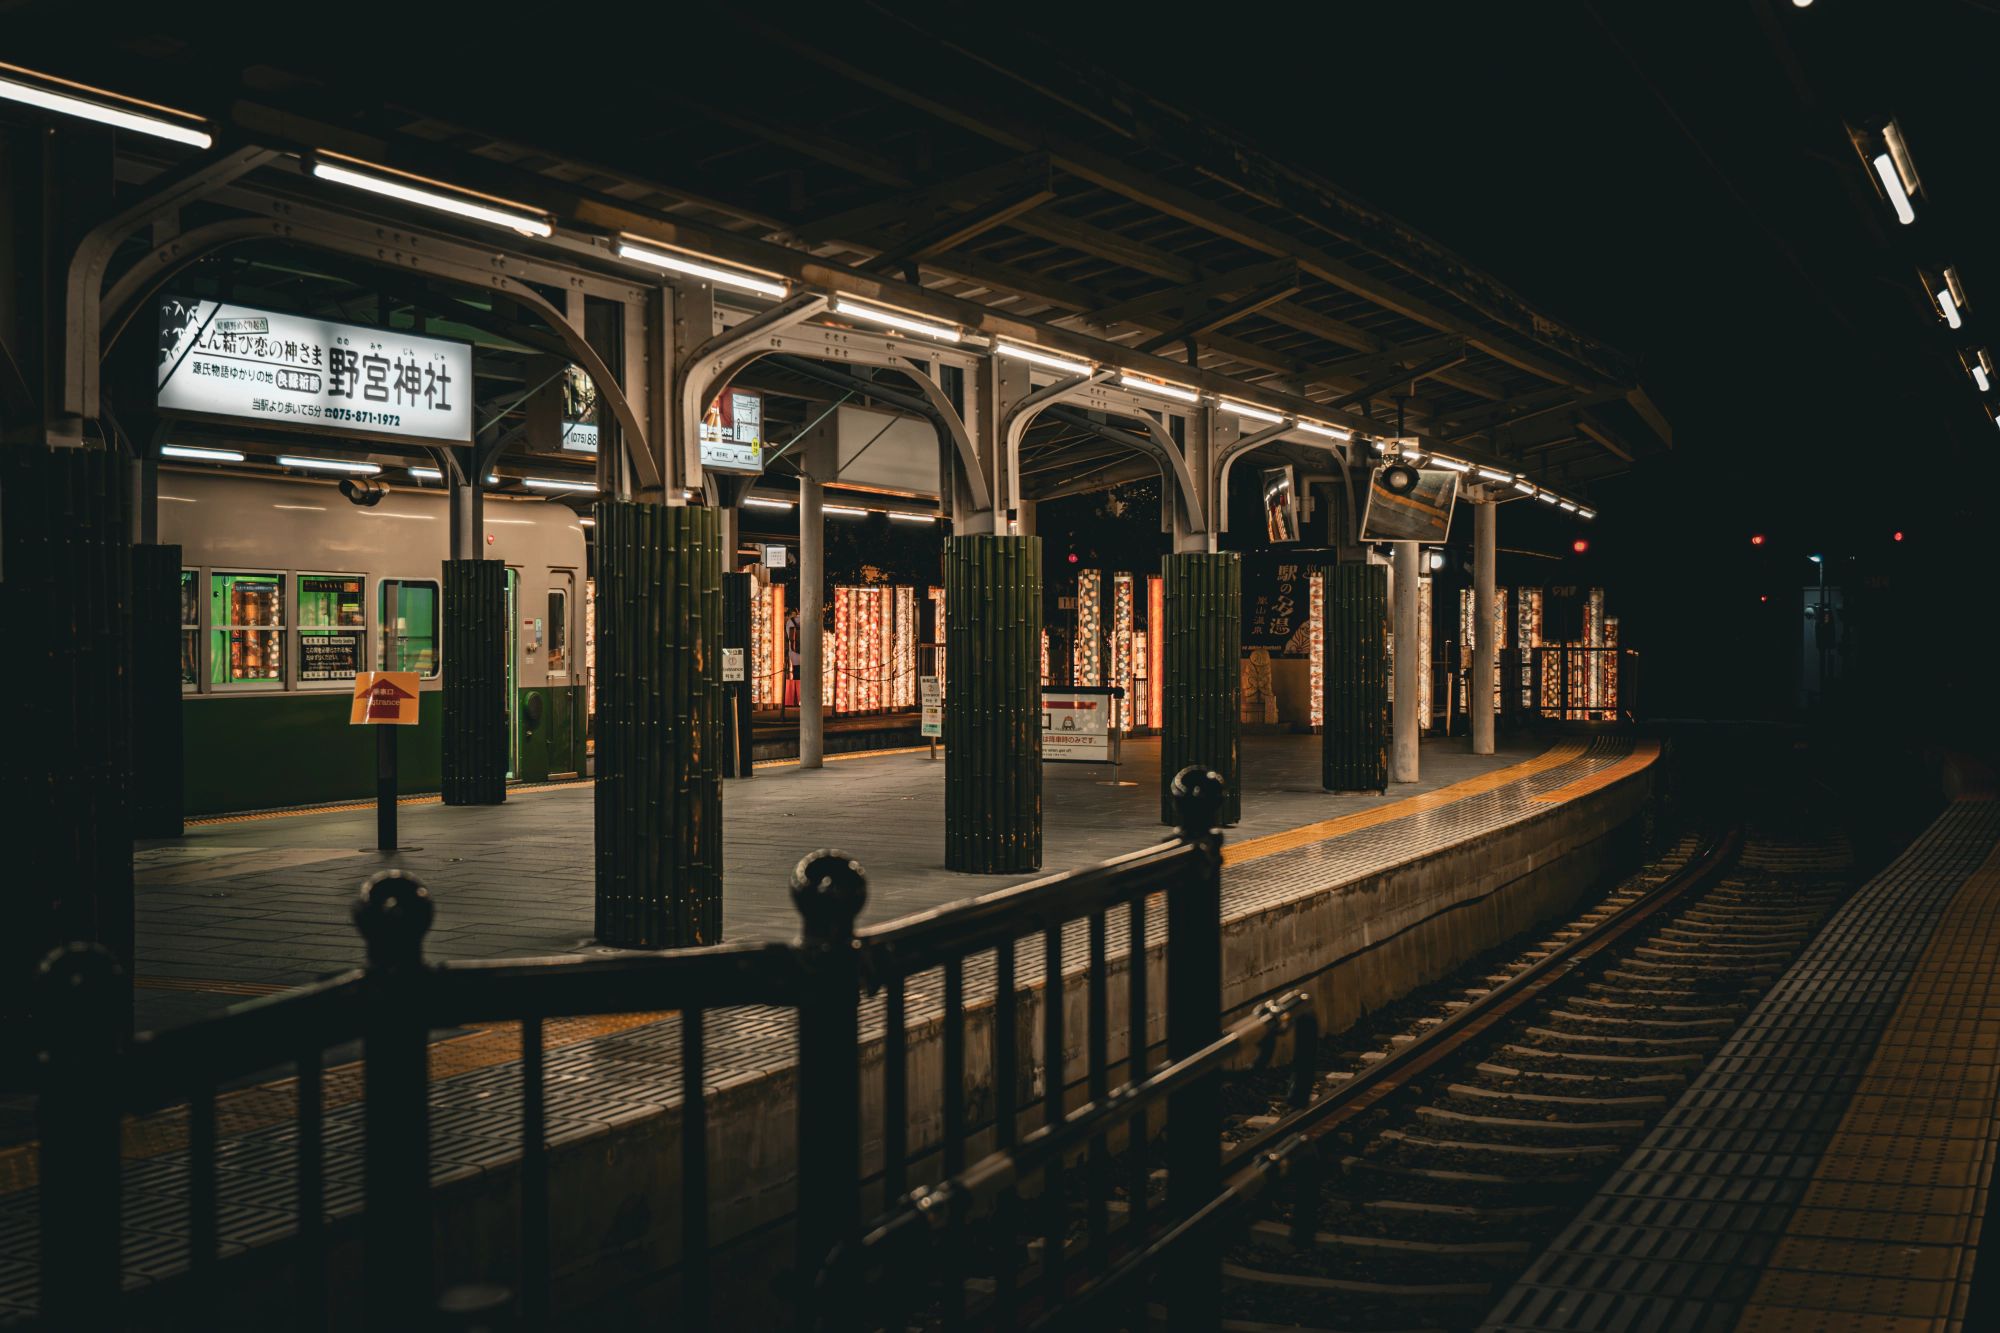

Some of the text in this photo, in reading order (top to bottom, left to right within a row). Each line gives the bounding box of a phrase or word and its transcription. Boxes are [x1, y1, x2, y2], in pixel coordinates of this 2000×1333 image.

[192, 361, 274, 385] 源氏物語ゆかりの地
[327, 347, 452, 412] 野宮神社
[252, 398, 322, 418] 当駅より歩いて5分
